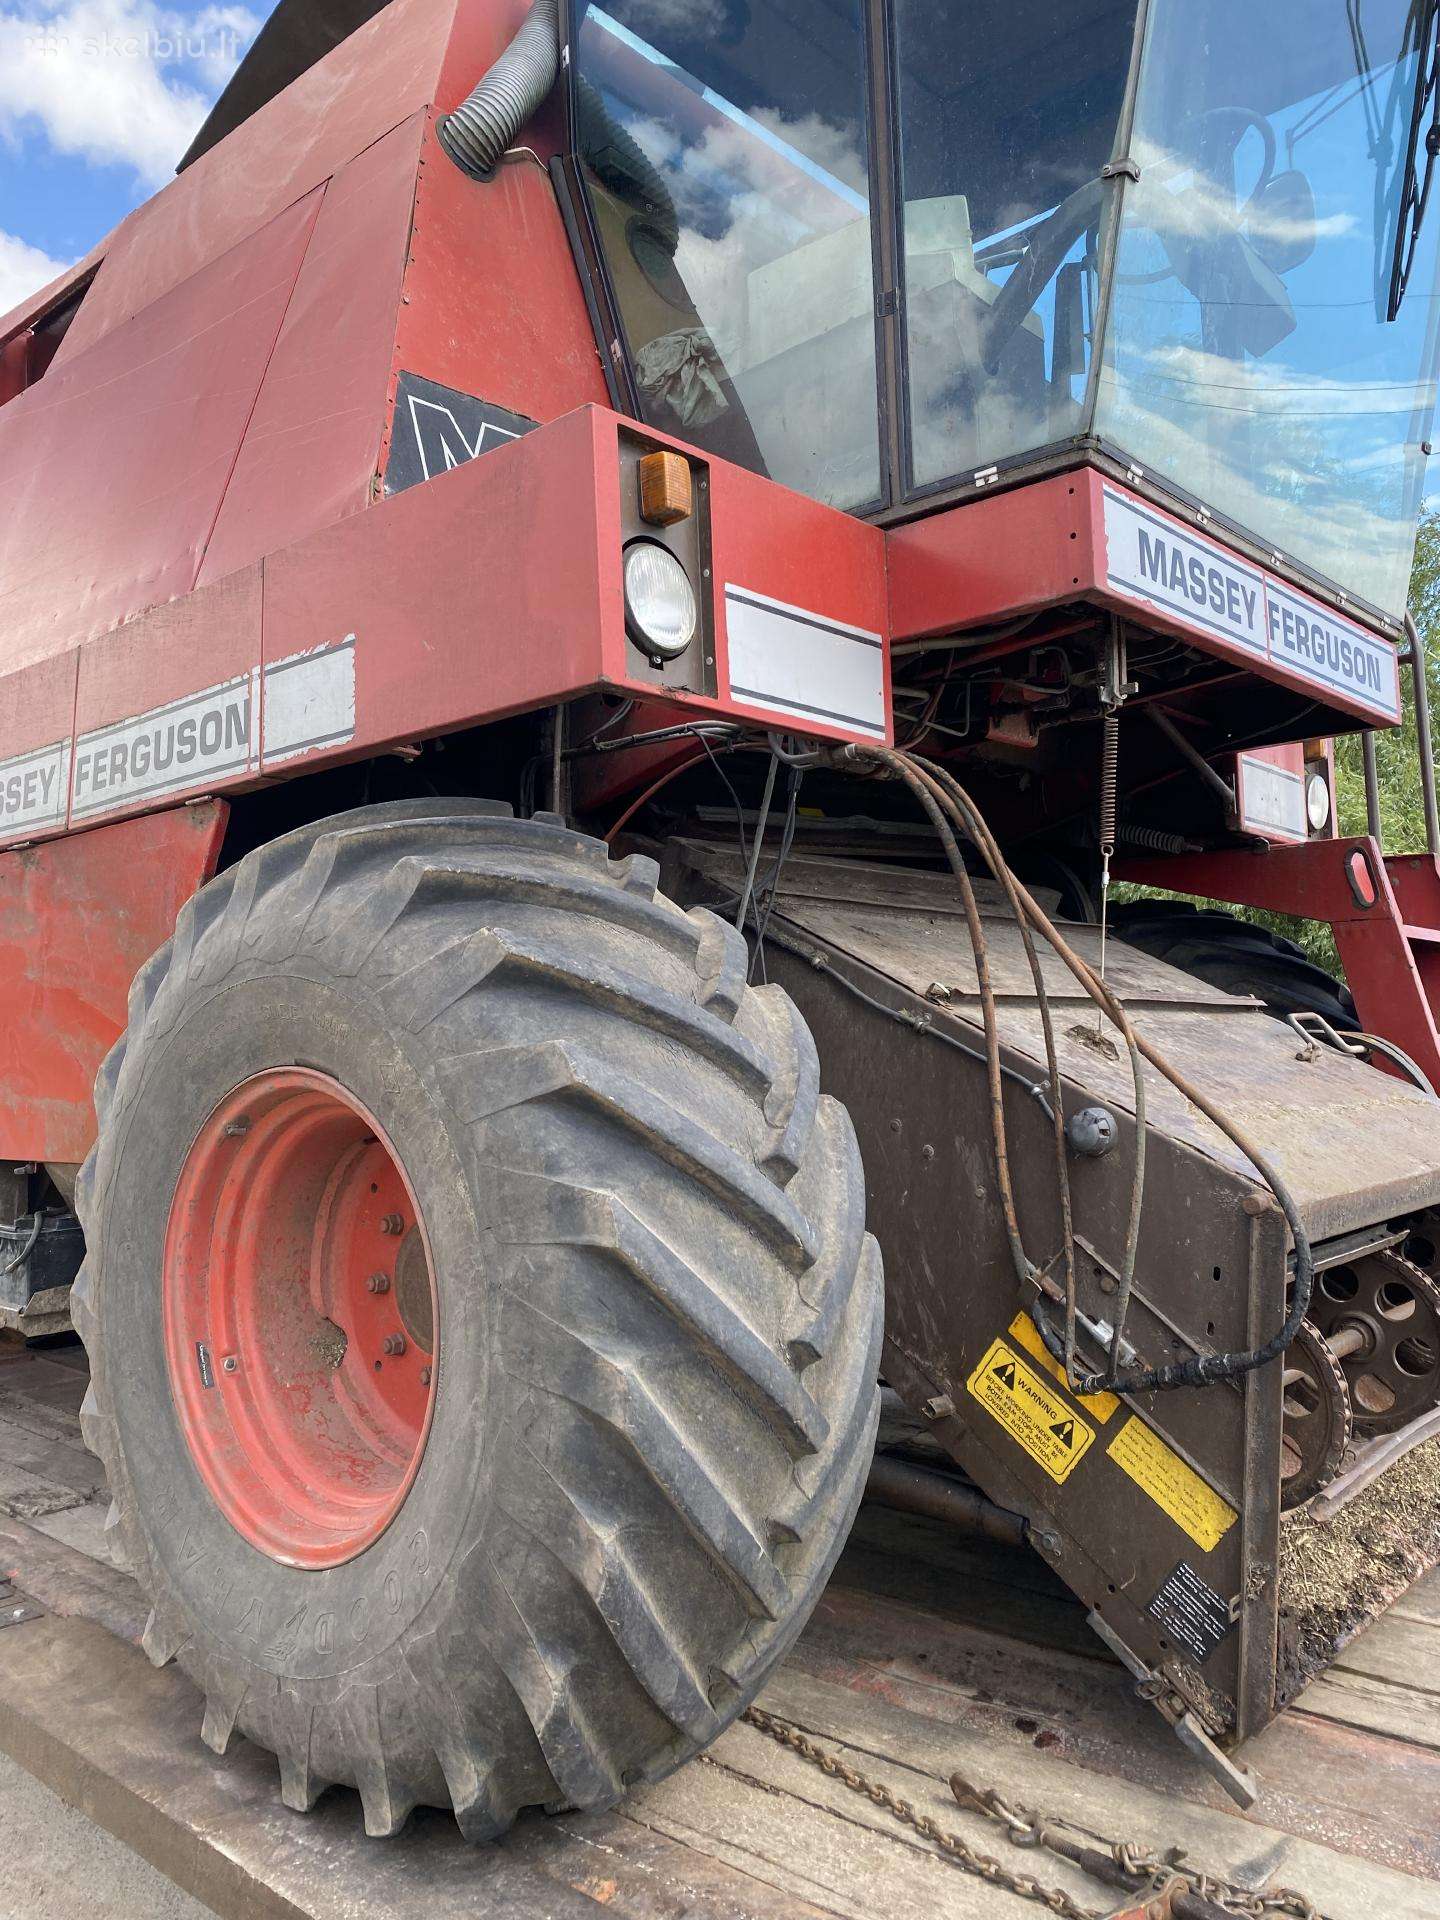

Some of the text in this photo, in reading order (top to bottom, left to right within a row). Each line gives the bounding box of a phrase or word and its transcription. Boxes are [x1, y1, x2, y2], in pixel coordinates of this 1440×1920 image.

[1137, 527, 1382, 693] MASSEY FERGUSON
[74, 698, 250, 797] FERGUSON
[984, 1393, 1052, 1462] LOWERED INTO POSITION
[985, 1374, 1068, 1459] BEFORE WORKING UNDER TABLE
[986, 1385, 1003, 1402] BOTH
[1017, 1416, 1034, 1434] STOPS
[1034, 1433, 1051, 1450] MUST
[1018, 1378, 1058, 1420] WARNING
